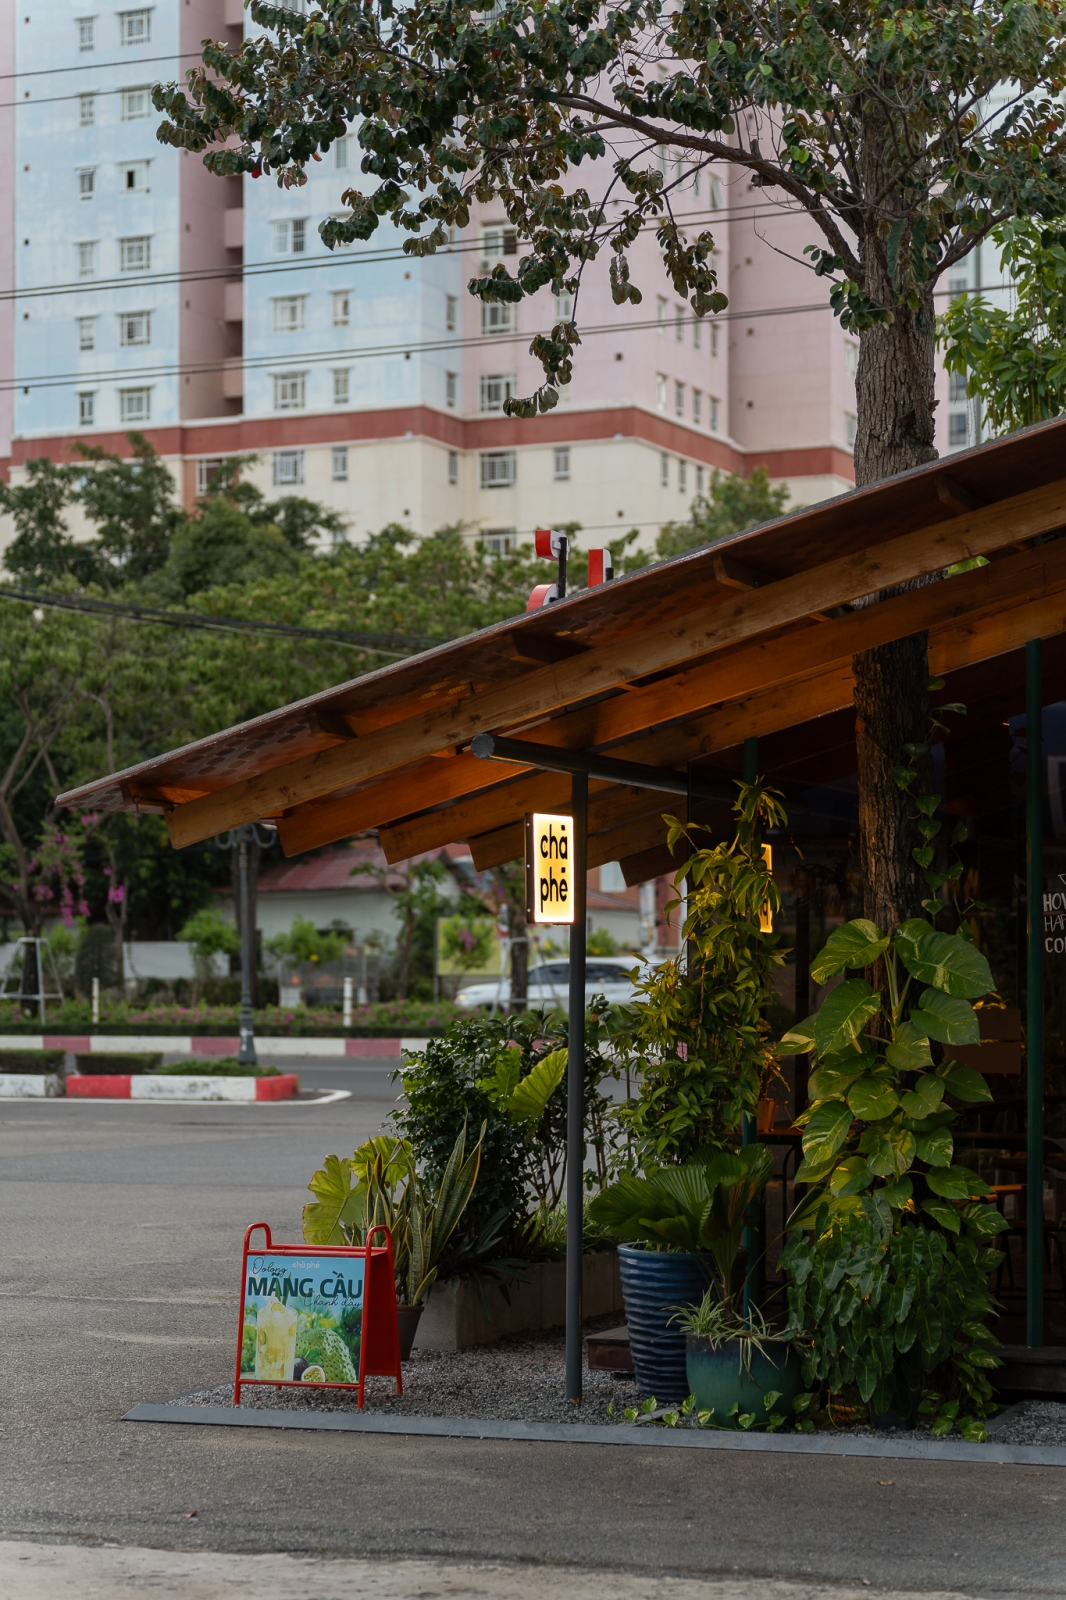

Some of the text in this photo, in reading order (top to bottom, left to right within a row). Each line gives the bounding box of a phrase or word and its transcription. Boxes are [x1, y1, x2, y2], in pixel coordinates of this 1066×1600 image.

[1044, 937, 1066, 953] CO
[253, 1257, 288, 1278] Oolong
[248, 1270, 362, 1299] MÃNG CẦU
[304, 1290, 338, 1307] Chanh
